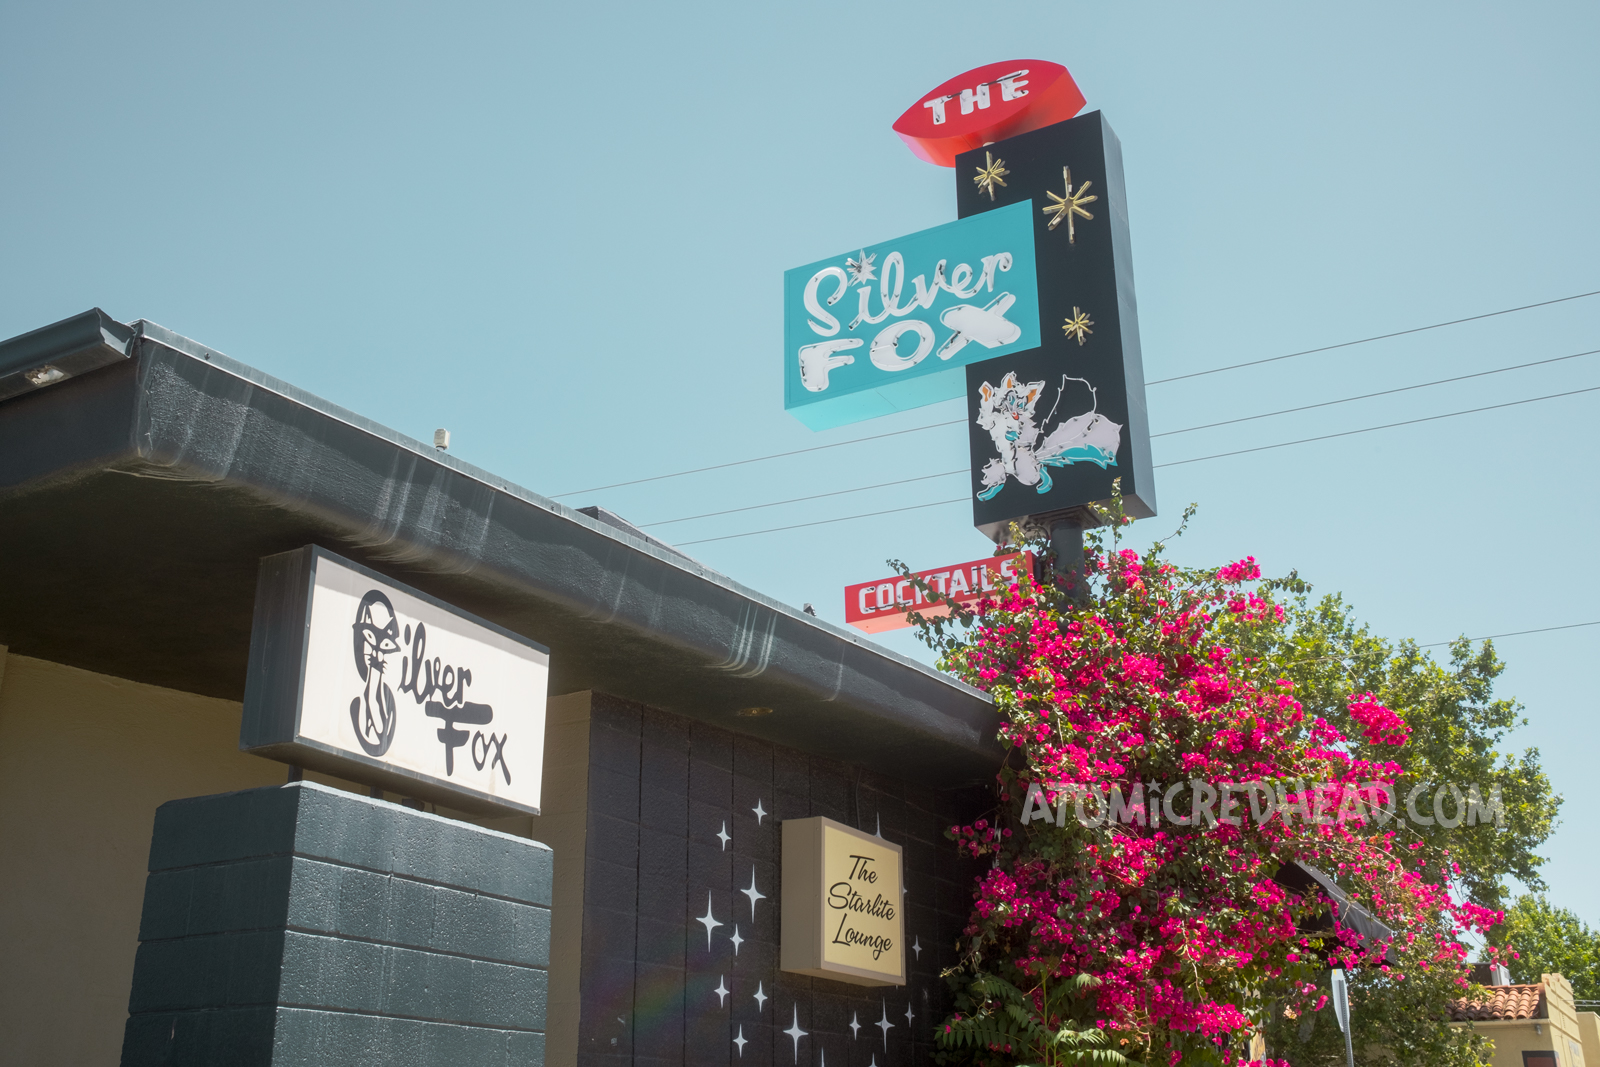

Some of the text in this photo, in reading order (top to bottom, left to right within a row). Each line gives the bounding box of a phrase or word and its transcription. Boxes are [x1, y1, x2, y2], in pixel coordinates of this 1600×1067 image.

[923, 69, 1030, 125] THE
[803, 251, 1013, 337] Silver
[798, 291, 1022, 392] FOX
[858, 558, 1019, 615] COCKTAILS
[424, 700, 512, 786] Fox
[849, 854, 878, 884] The
[827, 881, 896, 921] Starlite
[831, 912, 894, 961] Lounge
